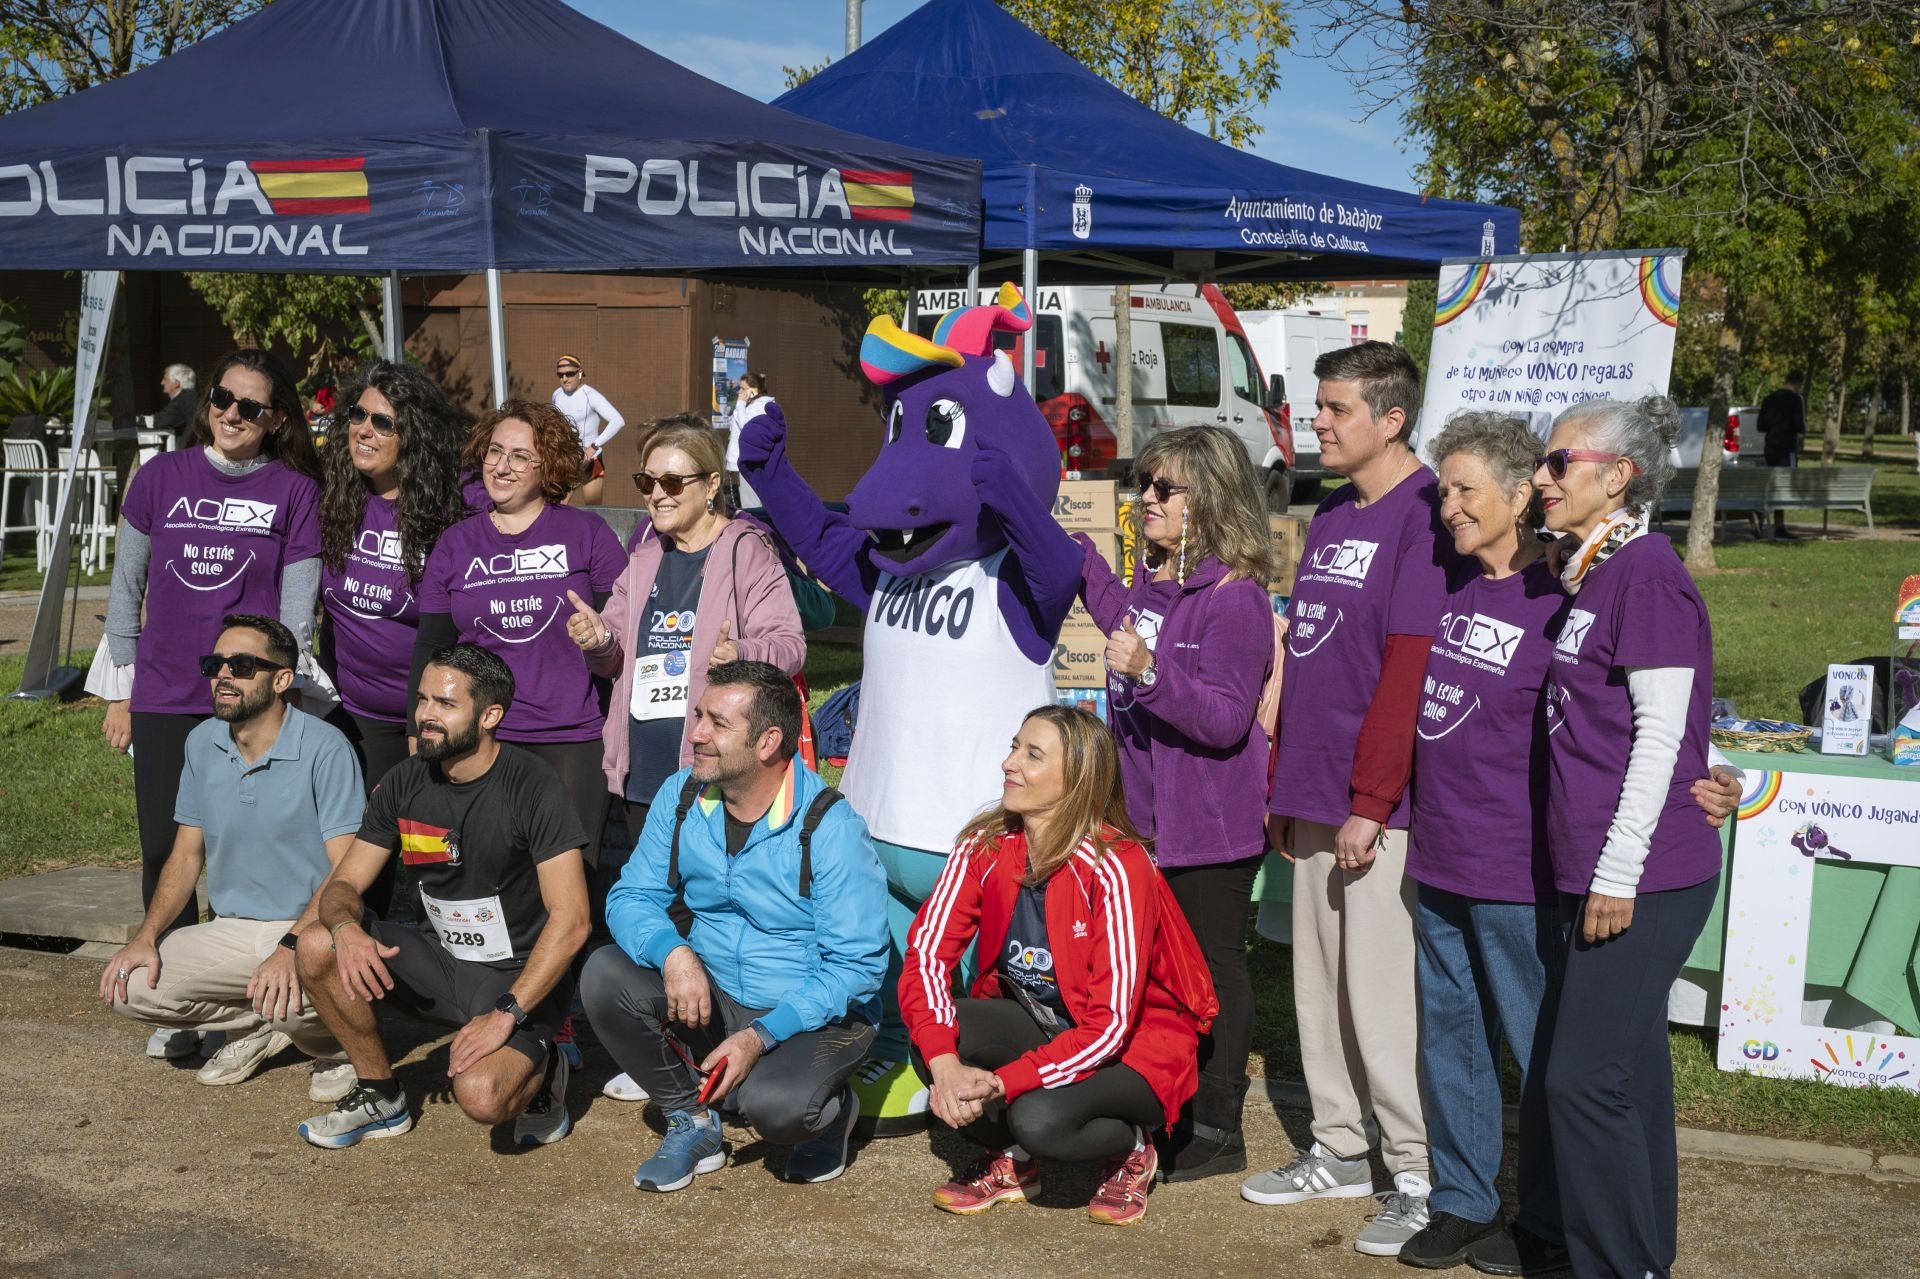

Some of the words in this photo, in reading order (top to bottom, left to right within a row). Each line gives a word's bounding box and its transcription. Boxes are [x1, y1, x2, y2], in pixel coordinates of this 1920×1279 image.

[0, 156, 274, 216] OLICÍA
[1224, 195, 1315, 222] Ayuntamiento
[1319, 202, 1334, 224] de
[1337, 204, 1383, 232] Badajoz
[106, 223, 368, 256] NACIONAL
[738, 226, 913, 256] NACIONAL
[1241, 228, 1308, 248] Concejalía
[1310, 232, 1325, 248] de
[1327, 234, 1369, 252] Cultura
[1145, 297, 1192, 313] AMBULANCIA
[1139, 349, 1157, 369] Roja
[1446, 366, 1459, 379] de
[1527, 362, 1578, 381] VONCO
[1461, 388, 1486, 402] otro
[1489, 390, 1495, 401] a
[167, 497, 275, 526] AOEX
[164, 521, 197, 529] Asociación
[197, 522, 234, 532] Oncológica
[235, 526, 270, 536] Extremeña
[184, 543, 199, 558] NO
[203, 545, 235, 561] ESTÁS
[191, 561, 223, 576] SOL@
[465, 548, 568, 579] AOEX
[344, 576, 359, 593] NO
[363, 583, 392, 601] ESTÁS
[463, 579, 496, 590] Asociación
[497, 574, 534, 584] Oncológica
[352, 596, 383, 611] SOL@
[490, 599, 506, 614] NO
[511, 595, 543, 613] ESTÁS
[874, 576, 975, 640] VONCO
[1296, 600, 1306, 617] NO
[502, 615, 533, 629] SOL@
[650, 610, 697, 632] 200
[1472, 658, 1506, 677] Extremeña
[1832, 670, 1863, 681] VONCO
[1424, 675, 1436, 695] NO
[1437, 685, 1464, 705] ESTÁS
[1423, 700, 1447, 722] SOL@
[1812, 802, 1863, 819] VONCO
[443, 929, 485, 946] 2289
[1008, 940, 1053, 971] 200
[1743, 1039, 1780, 1061] GD
[1832, 1068, 1887, 1083] vonco.org
